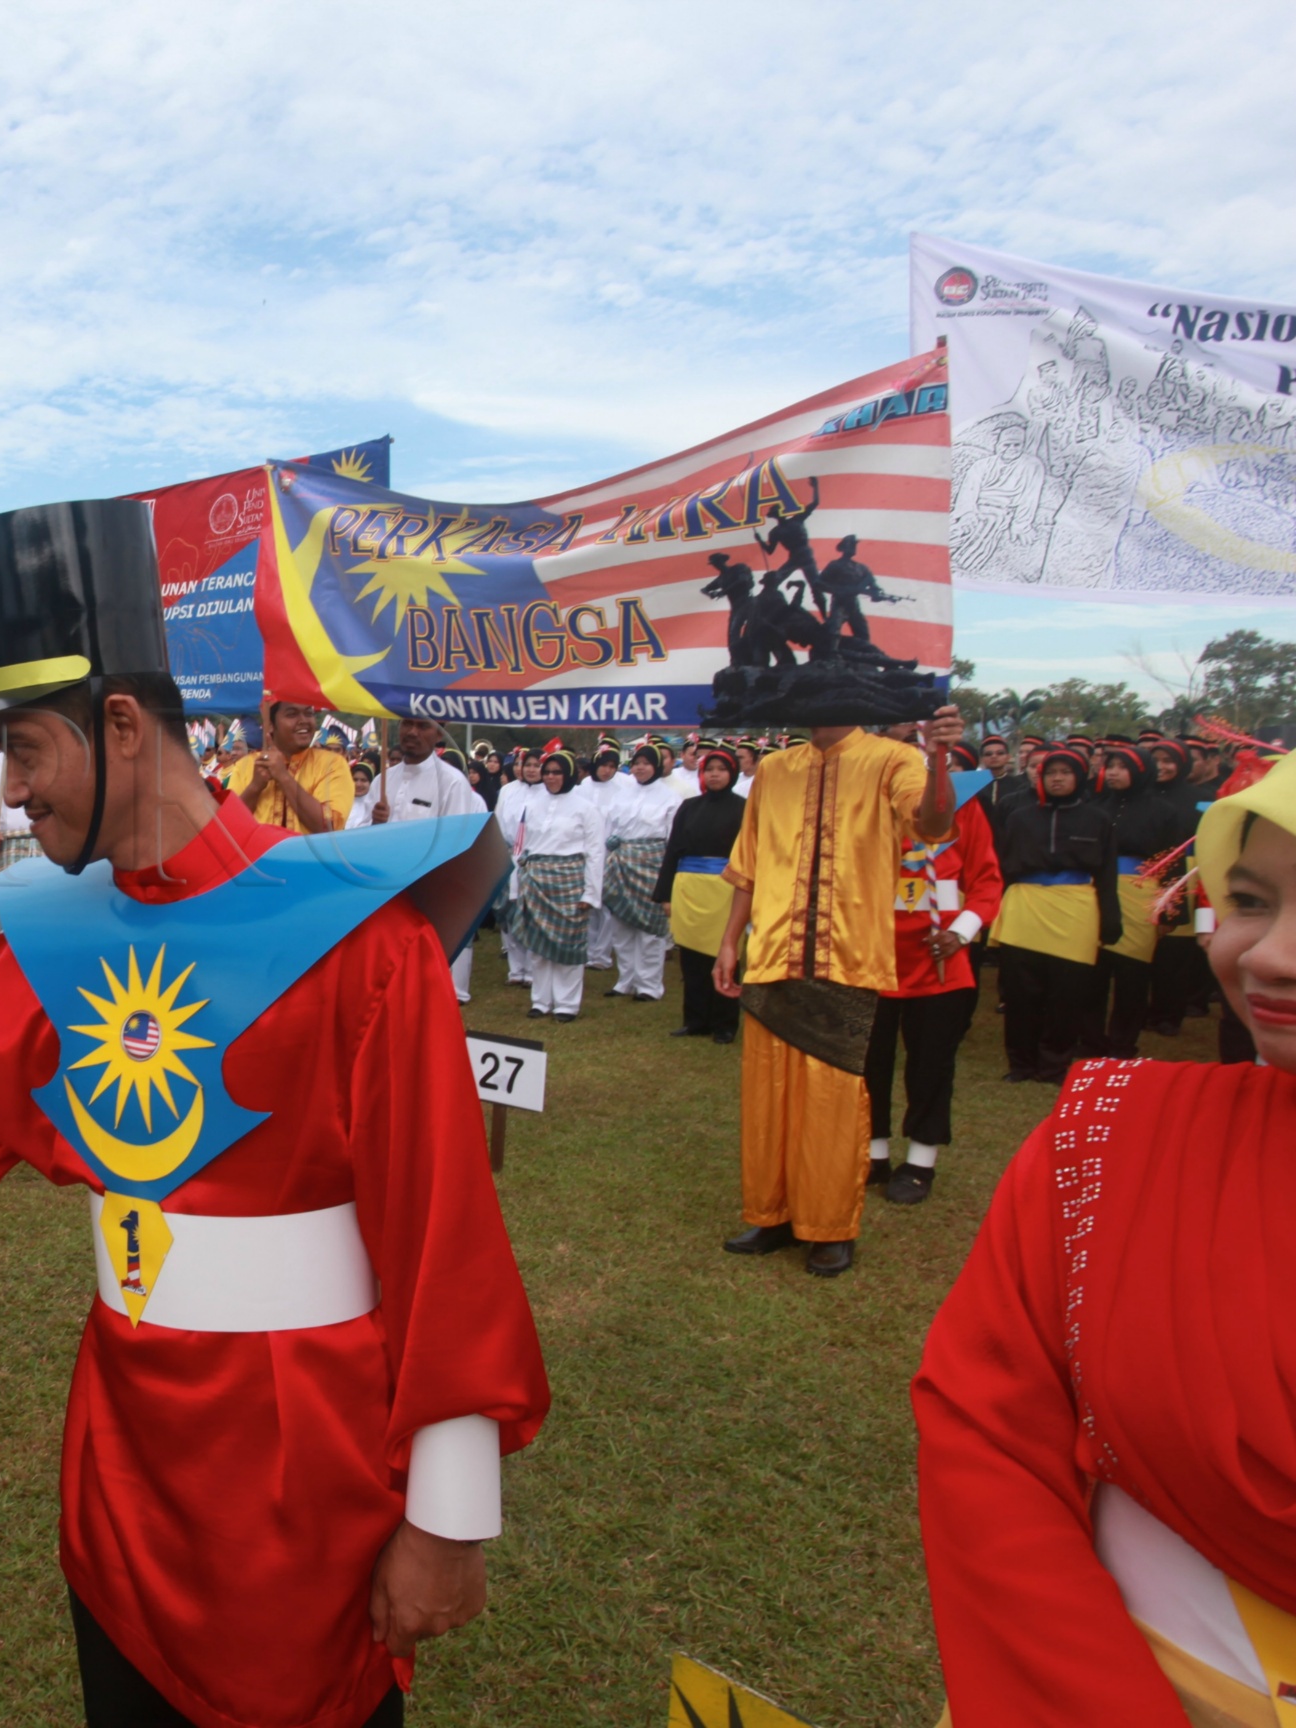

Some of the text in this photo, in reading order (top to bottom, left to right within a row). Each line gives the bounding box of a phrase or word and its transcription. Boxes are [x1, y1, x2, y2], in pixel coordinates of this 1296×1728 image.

[328, 455, 806, 564] PERKASA WIRA
[406, 597, 668, 674] BANGSA
[409, 693, 669, 721] KONTINJEN KHAR
[479, 1051, 525, 1095] 27
